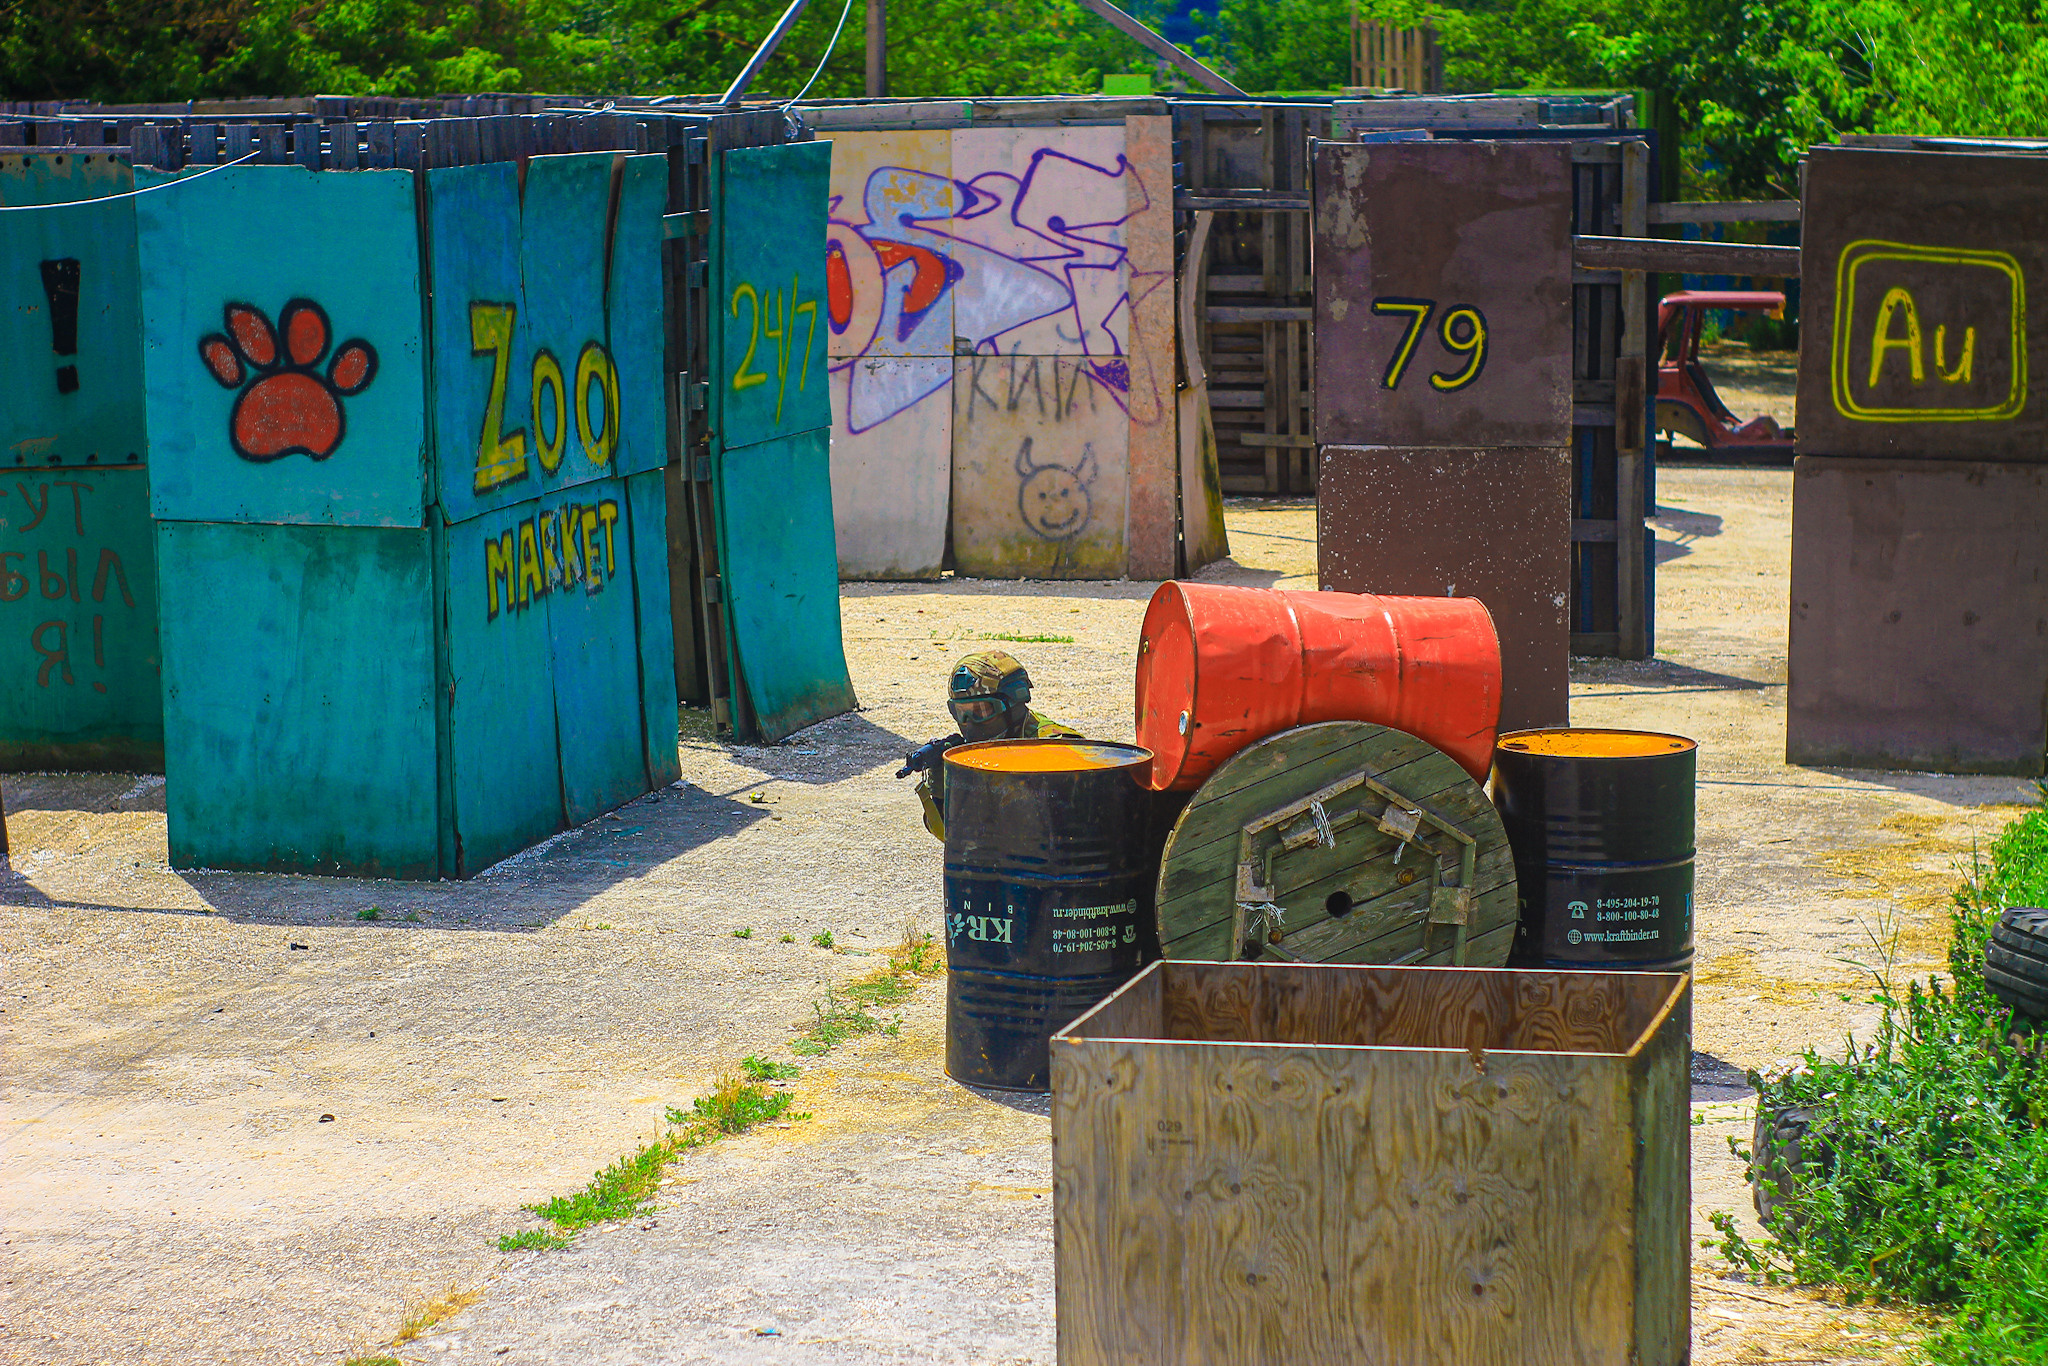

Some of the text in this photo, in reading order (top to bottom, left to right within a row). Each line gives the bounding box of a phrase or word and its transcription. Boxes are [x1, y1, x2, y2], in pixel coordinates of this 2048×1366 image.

[731, 271, 817, 425] 24/7
[1371, 296, 1489, 393] 79
[1868, 287, 1975, 390] Au
[0, 481, 94, 536] УТ
[0, 548, 135, 608] БЫЛ
[484, 498, 619, 624] MARKET
[1052, 902, 1127, 920] www.kraftbinder.ru
[1596, 895, 1660, 909] 8-495-204-19-70
[1596, 908, 1660, 922] 8-800-100-80-48
[1052, 925, 1117, 940] 8-800-100-80-48
[1052, 938, 1117, 953] 8-495-204-19-70
[1583, 928, 1660, 943] www.kraftbinder.ru
